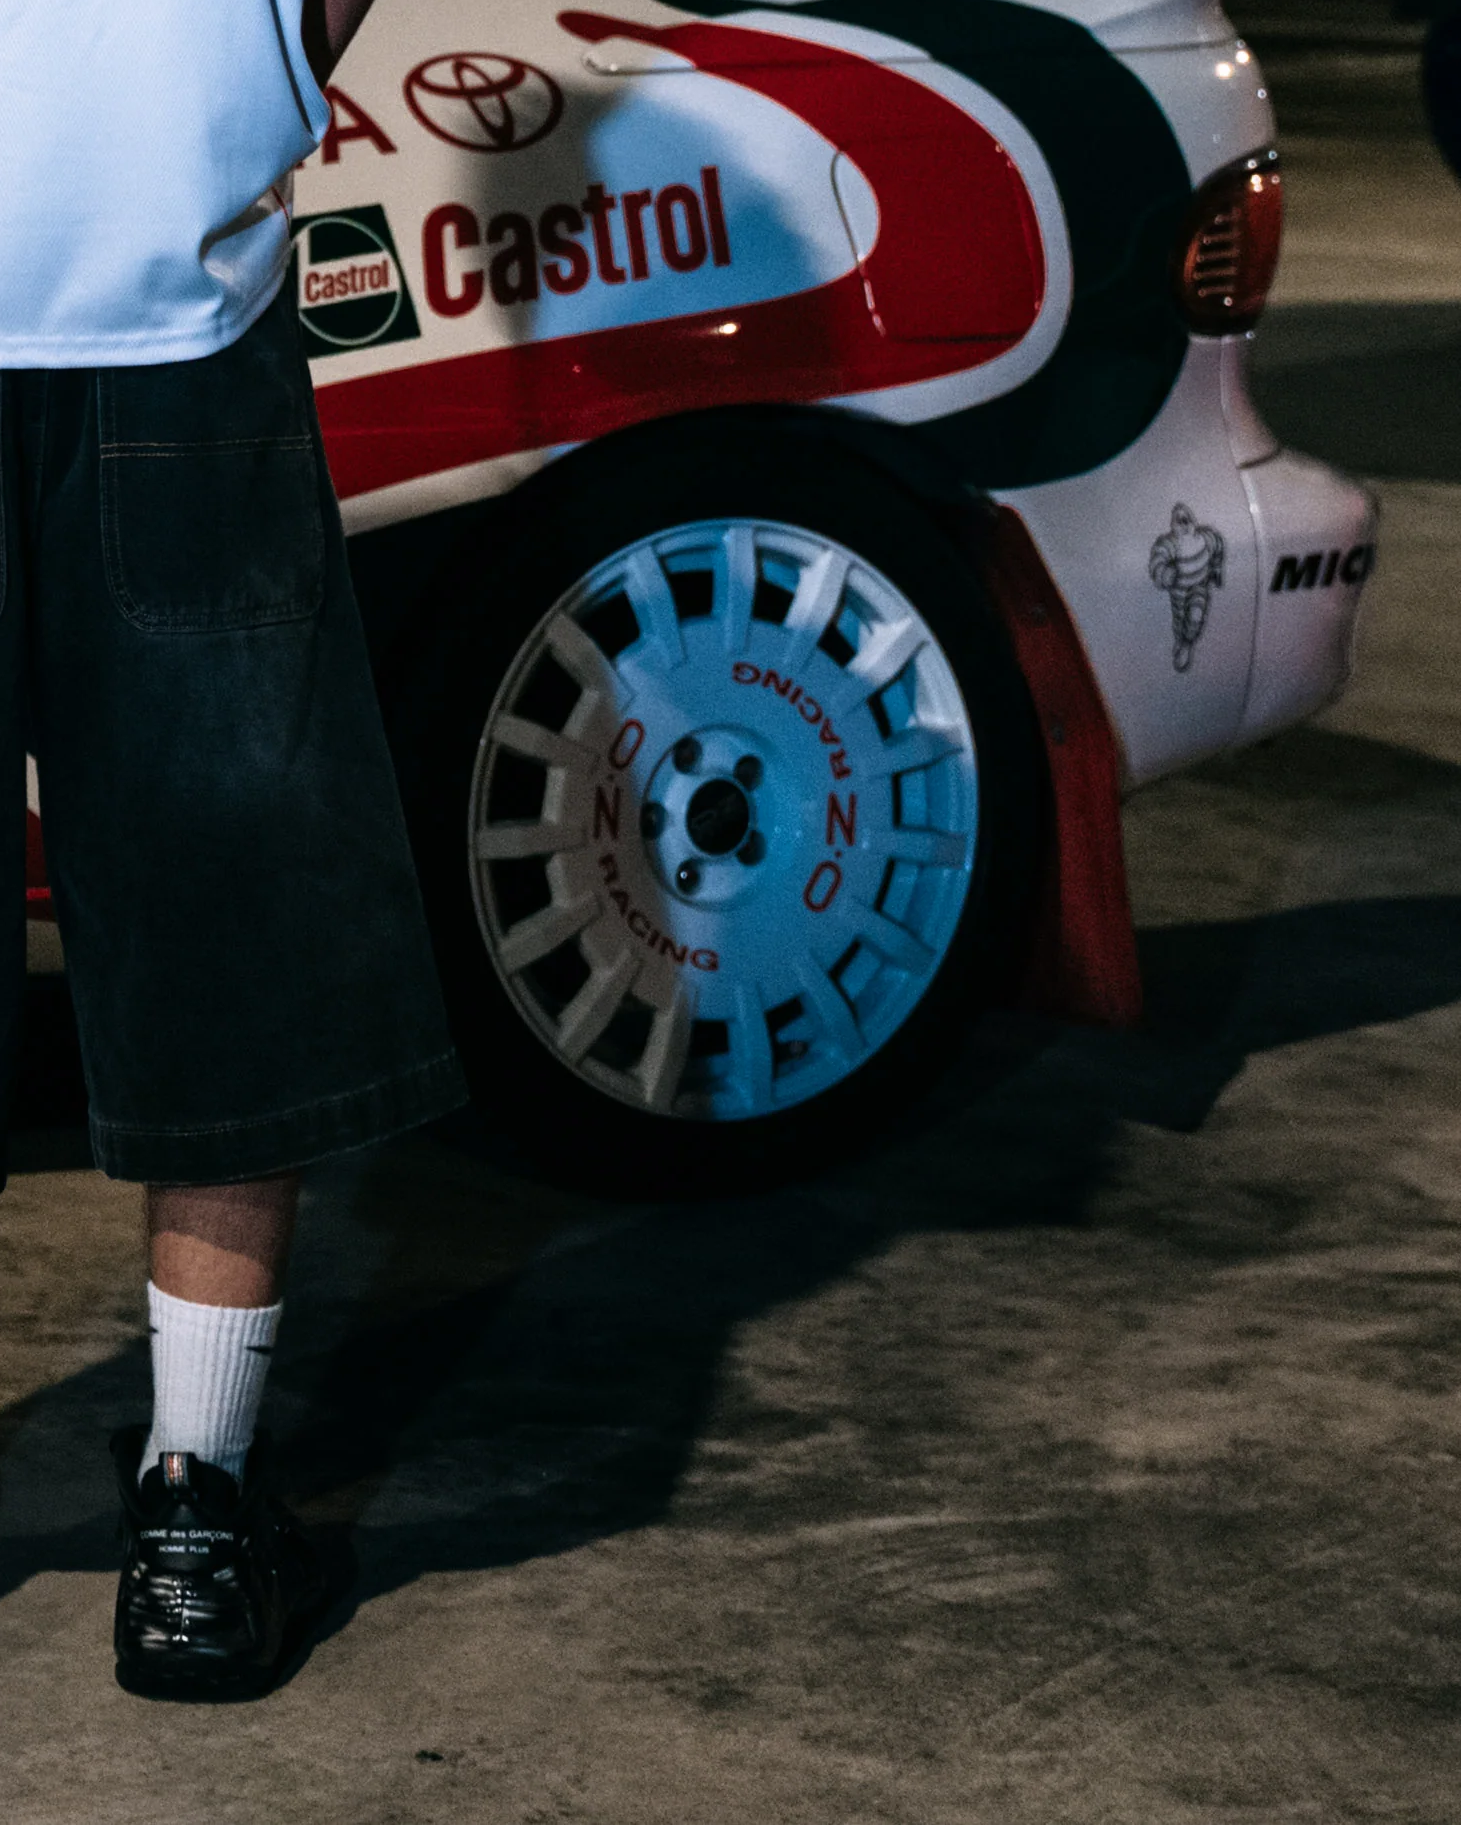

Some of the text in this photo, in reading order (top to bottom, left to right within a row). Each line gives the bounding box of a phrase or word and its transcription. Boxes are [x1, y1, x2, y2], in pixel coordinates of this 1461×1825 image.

[295, 85, 397, 169] A
[422, 166, 731, 318] Castrol
[304, 259, 389, 303] Castrol
[1268, 542, 1374, 594] MIC
